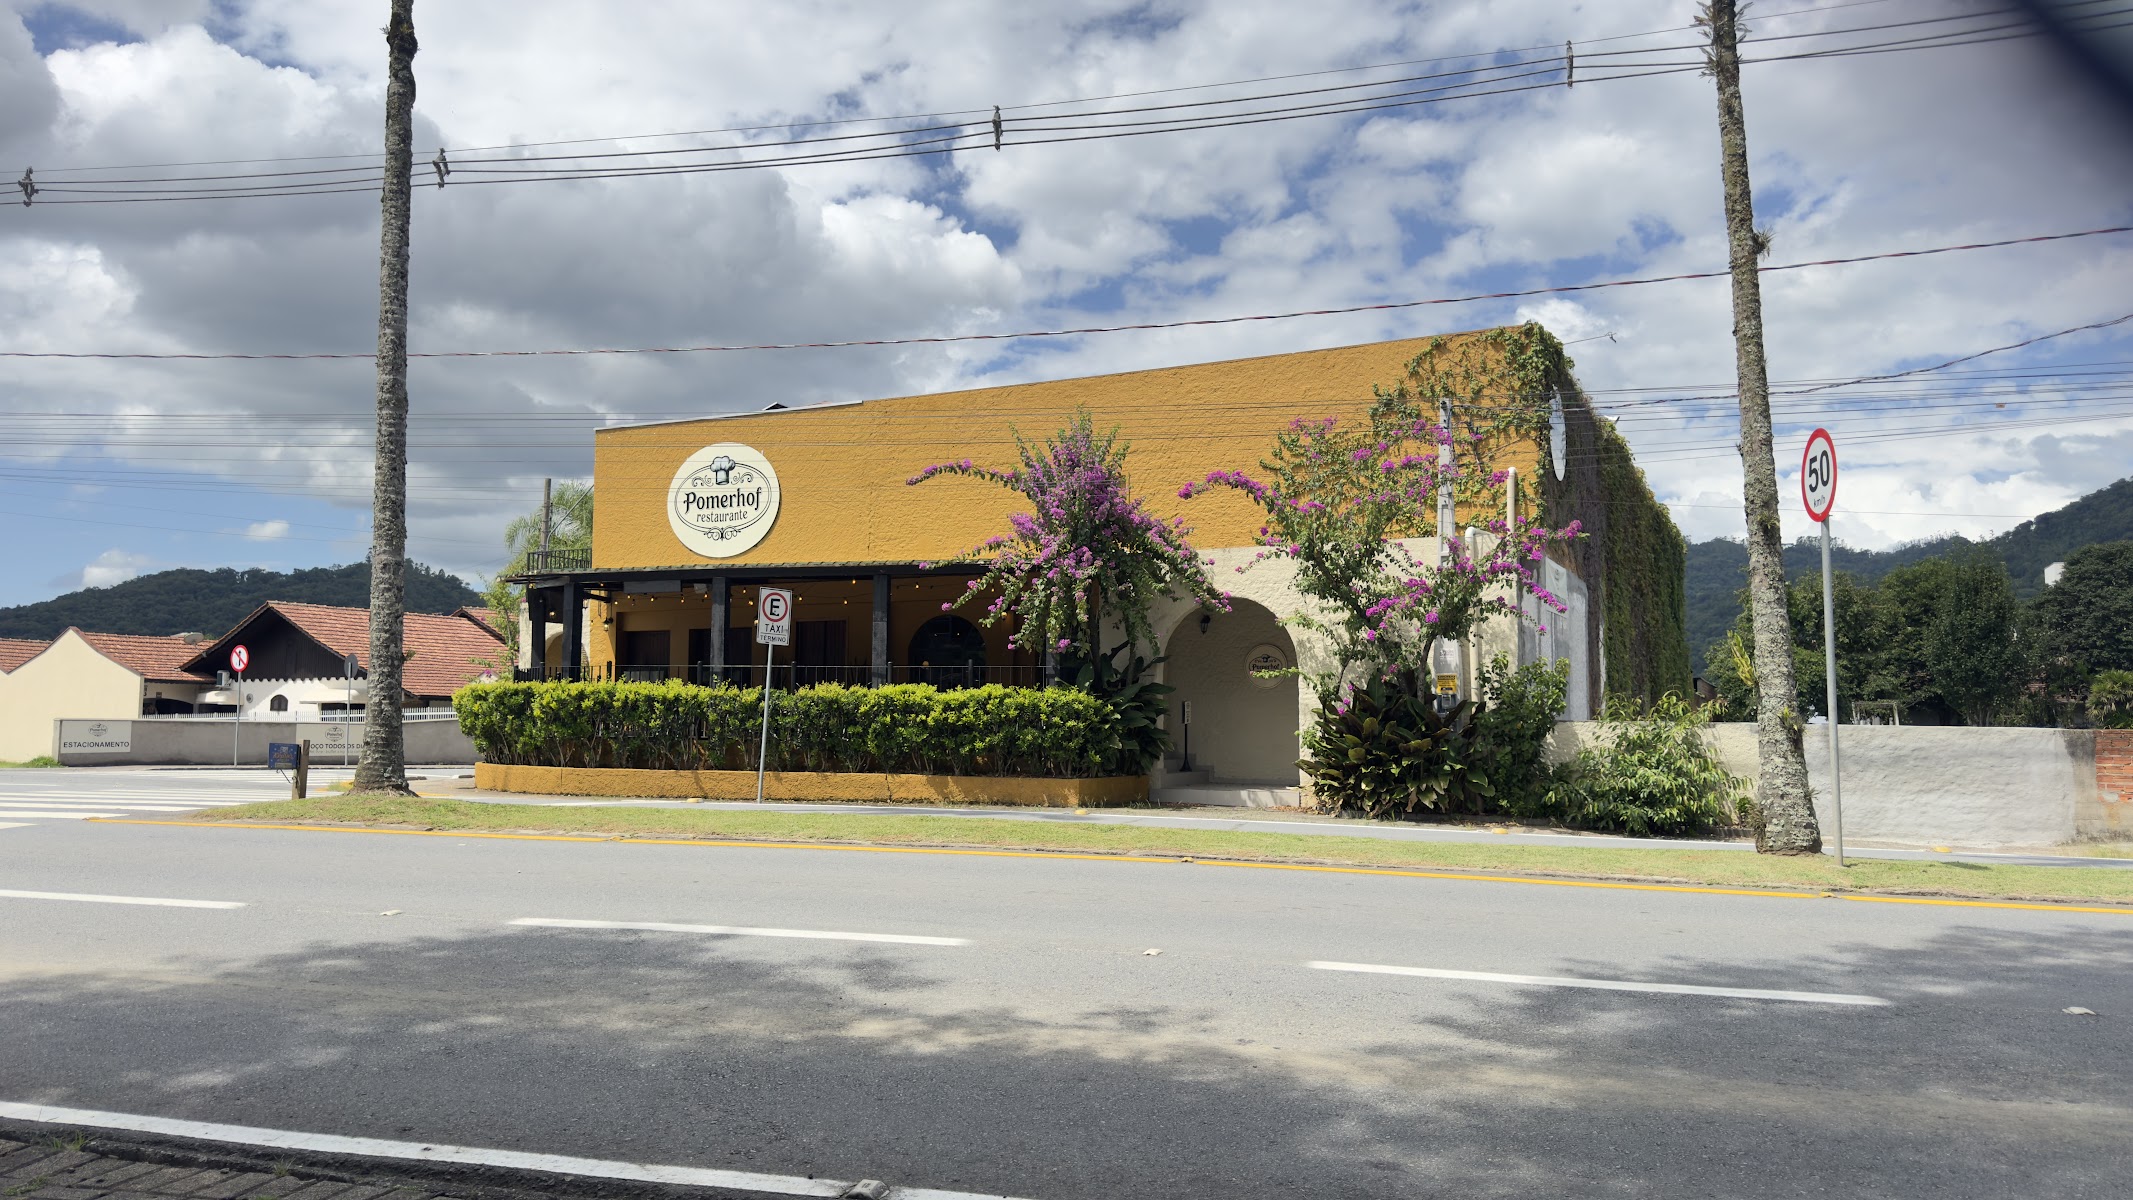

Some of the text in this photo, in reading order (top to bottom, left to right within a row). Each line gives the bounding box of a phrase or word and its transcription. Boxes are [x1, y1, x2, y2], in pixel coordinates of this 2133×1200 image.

[1808, 450, 1830, 493] 50
[683, 487, 762, 514] Pomerhof
[696, 509, 748, 523] restaurante
[769, 598, 781, 617] E
